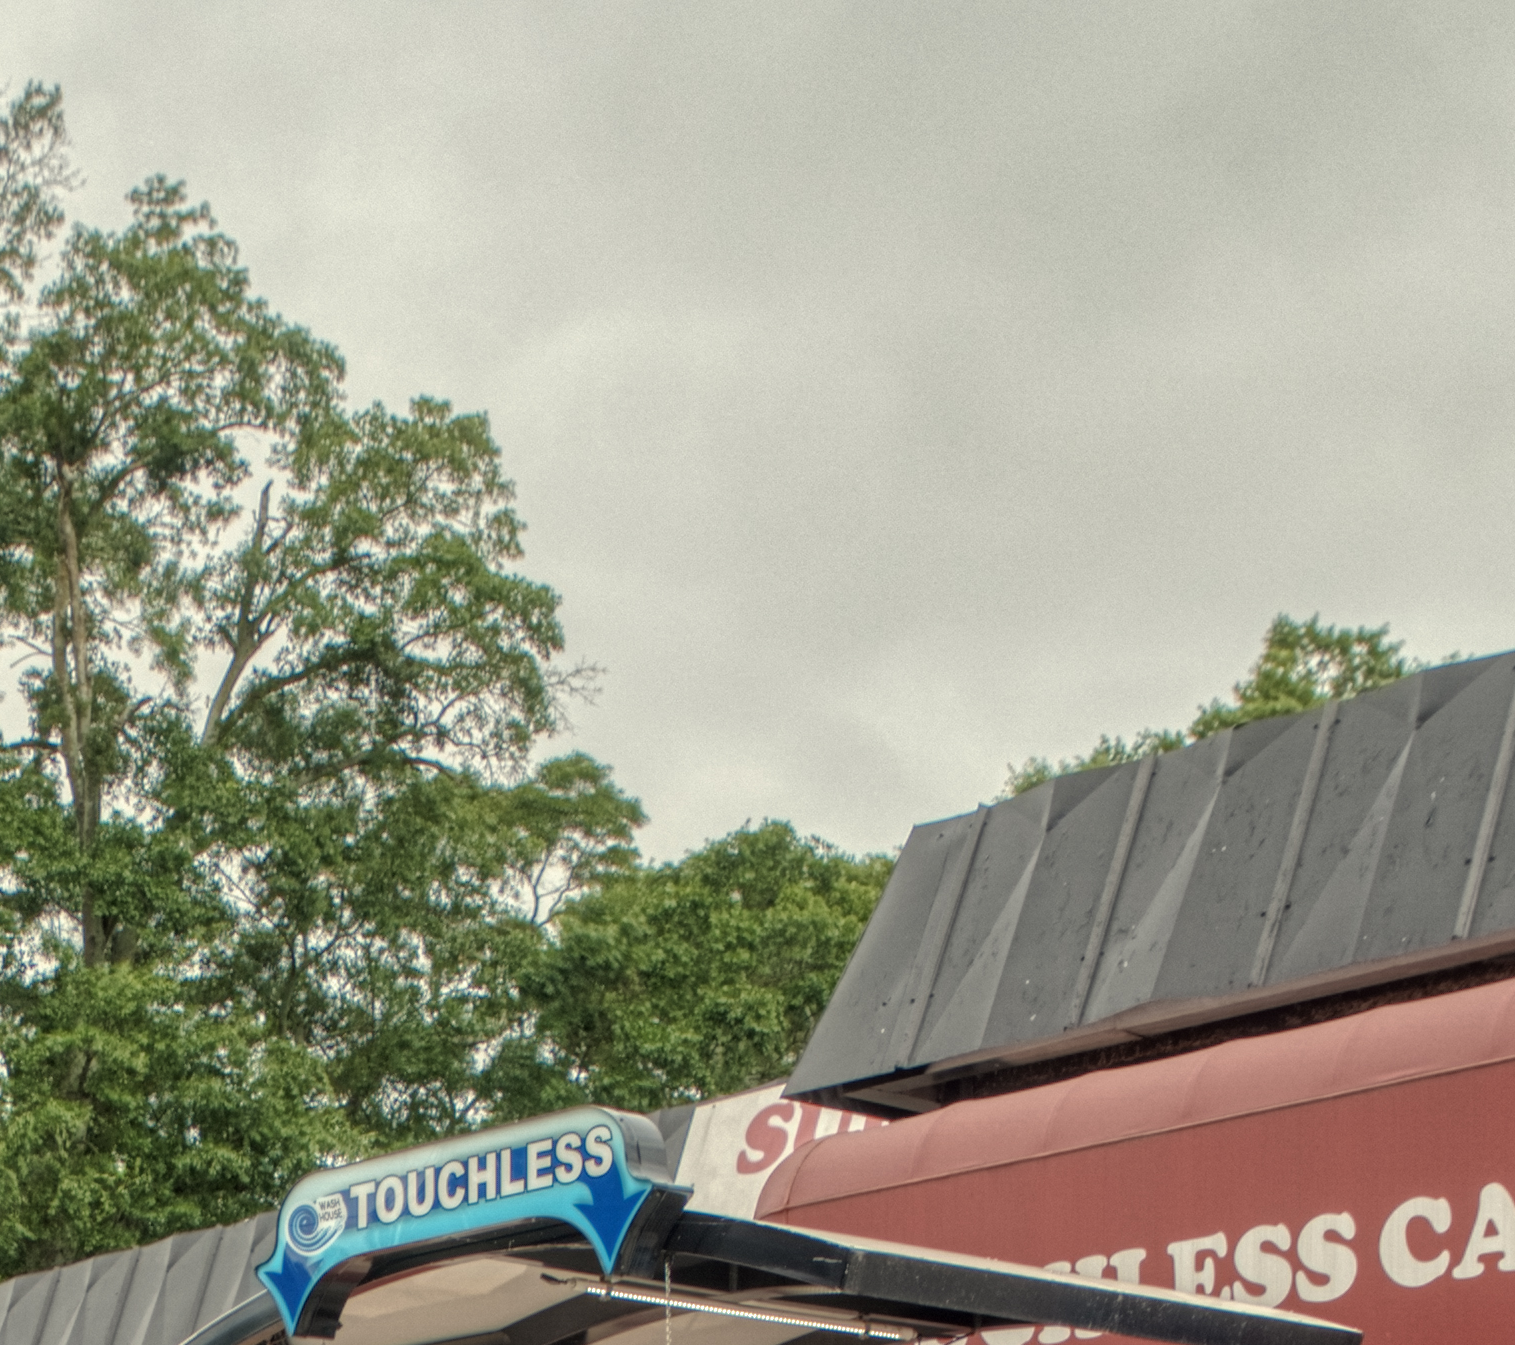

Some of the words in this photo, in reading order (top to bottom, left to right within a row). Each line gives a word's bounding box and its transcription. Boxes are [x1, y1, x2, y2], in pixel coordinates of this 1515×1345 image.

[348, 1124, 614, 1230] TOUCHLESS
[318, 1197, 341, 1210] WASH
[319, 1208, 344, 1222] HOUSE
